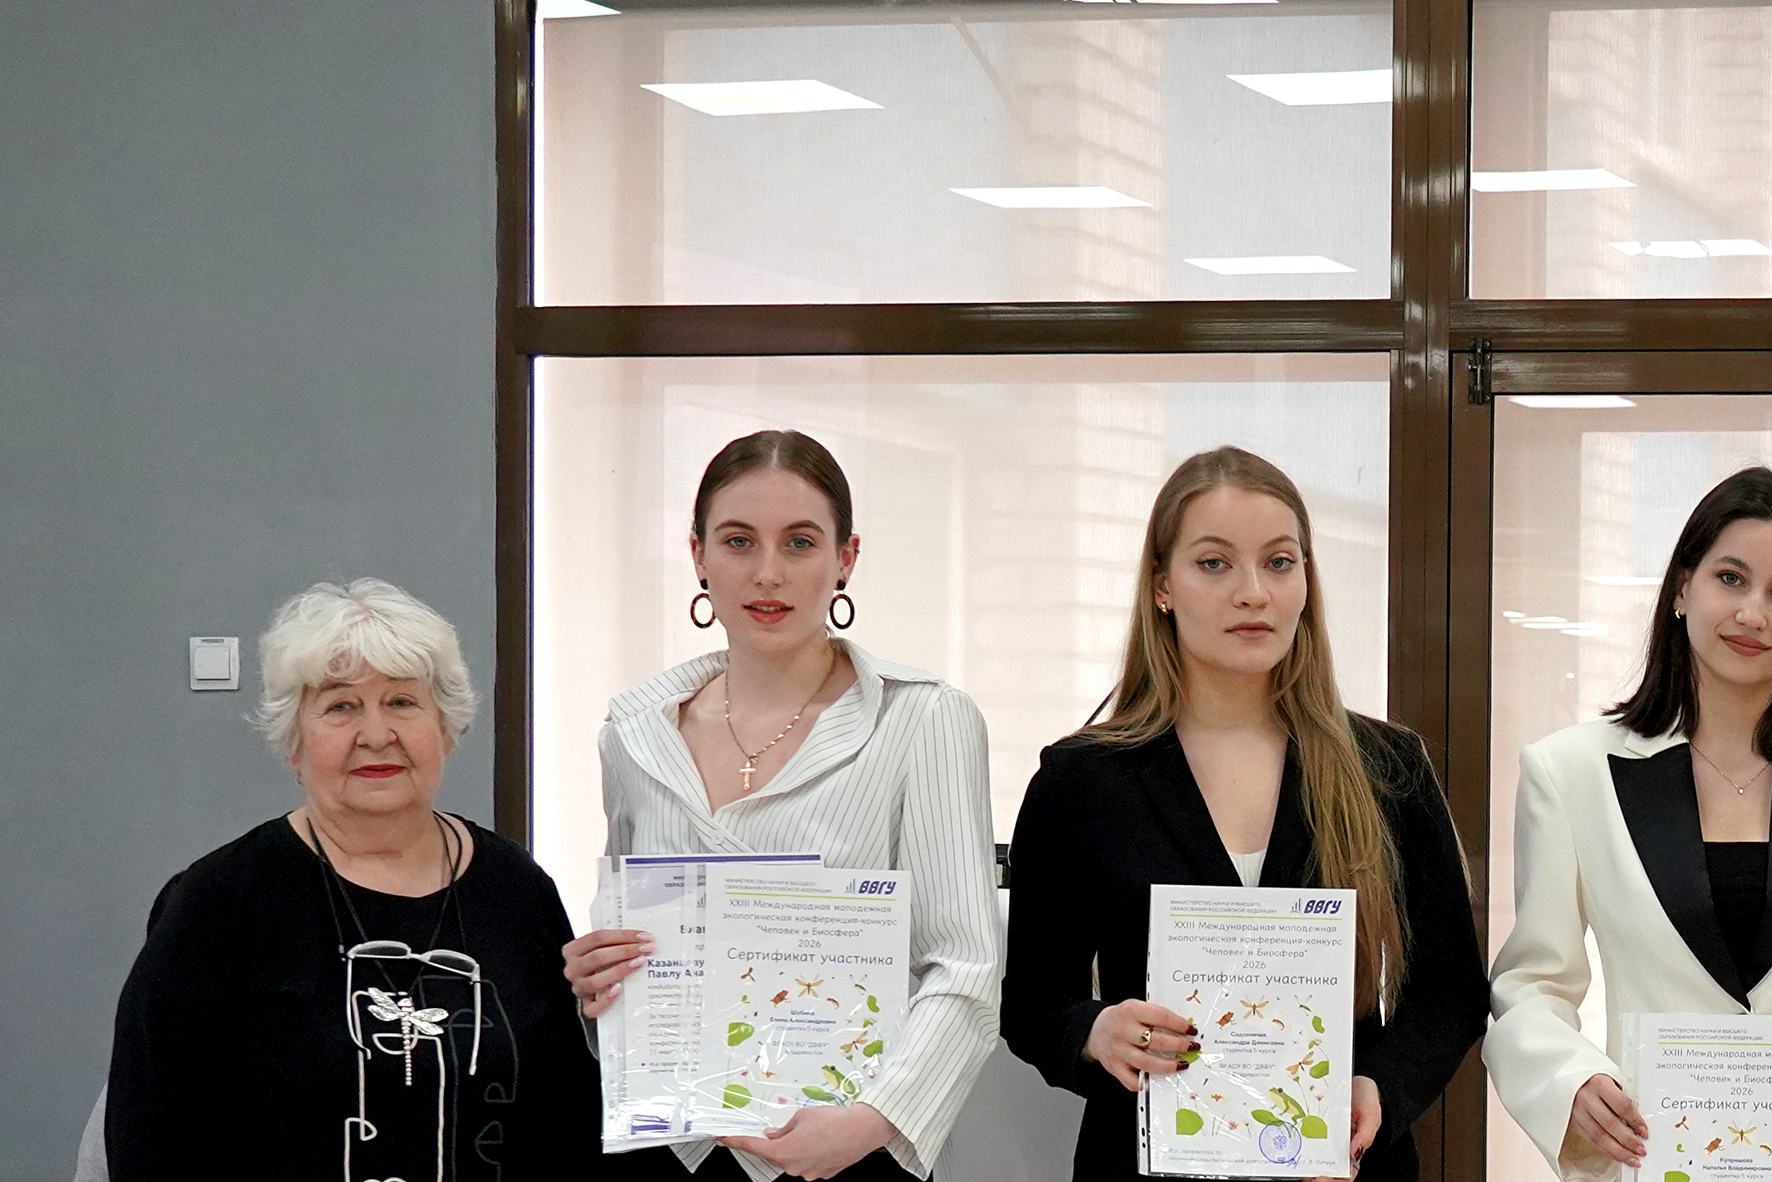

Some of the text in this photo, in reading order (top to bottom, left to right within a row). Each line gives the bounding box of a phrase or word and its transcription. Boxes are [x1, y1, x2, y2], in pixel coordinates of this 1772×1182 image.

[858, 880, 897, 895] ВВГУ
[729, 899, 891, 914] XXIII Международная молодежная
[1303, 899, 1342, 915] ВВГУ
[722, 912, 898, 926] экологическая конференция-конкурс
[1173, 920, 1337, 933] XXIII Международная молодежная
[798, 939, 822, 949] 2026
[1167, 934, 1343, 947] экологическая конференция-конкурс
[727, 947, 894, 966] Сертификат участника
[1247, 949, 1254, 957] и
[1242, 960, 1267, 970] 2026
[647, 969, 681, 980] Павлу
[1172, 969, 1338, 986] Сертификат участника
[1662, 1048, 1683, 1057] XXIII
[1686, 1049, 1762, 1060] Международная
[1656, 1062, 1724, 1070] экологическая
[1730, 1087, 1754, 1096] 2026
[1661, 1096, 1748, 1111] Сертификат
